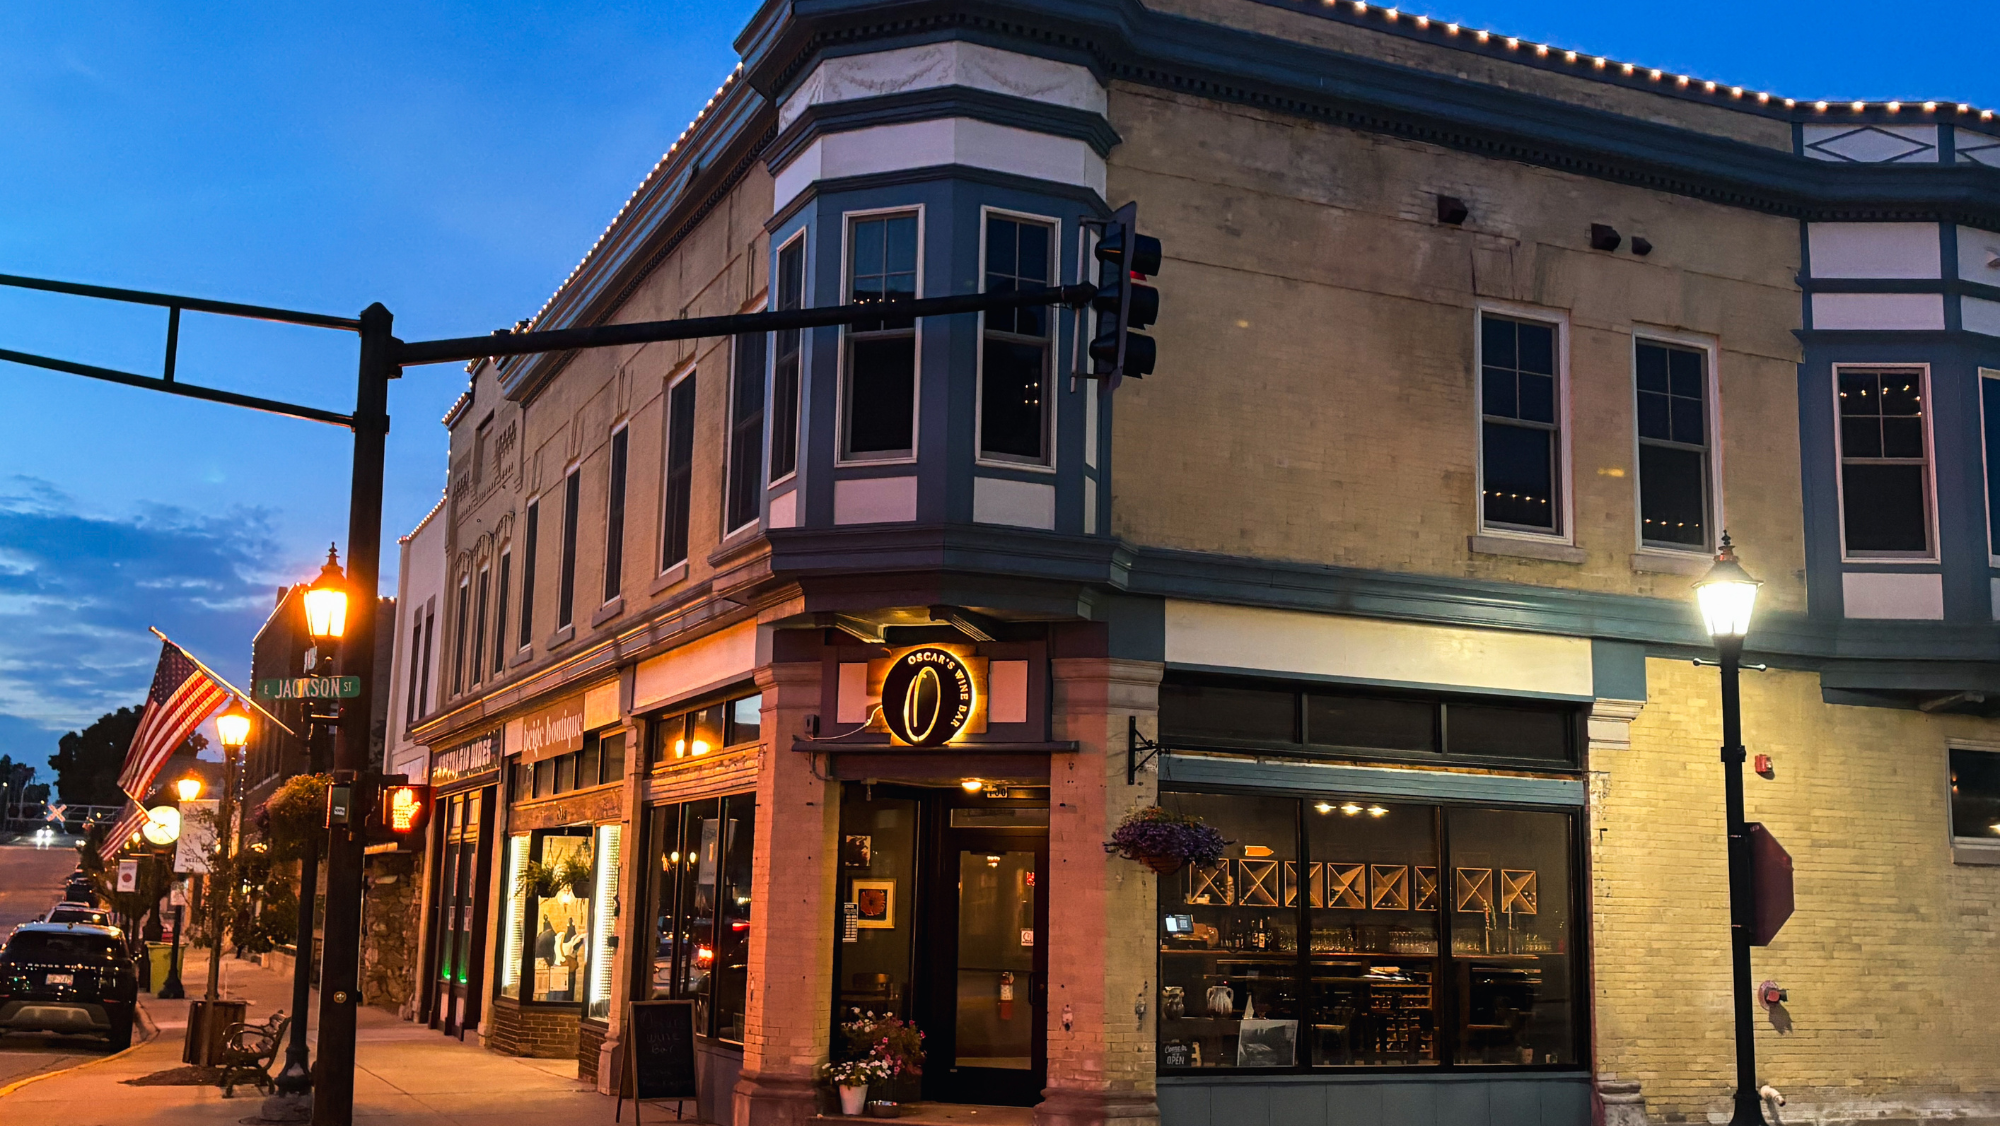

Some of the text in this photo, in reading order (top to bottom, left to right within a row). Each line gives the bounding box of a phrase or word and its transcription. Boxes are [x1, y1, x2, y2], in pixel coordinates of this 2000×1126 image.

[264, 679, 352, 698] E JACKSON ST
[908, 652, 969, 728] OSCAR'S WINE BAR
[523, 709, 583, 758] beige boutique
[1166, 1056, 1185, 1065] OPEN
